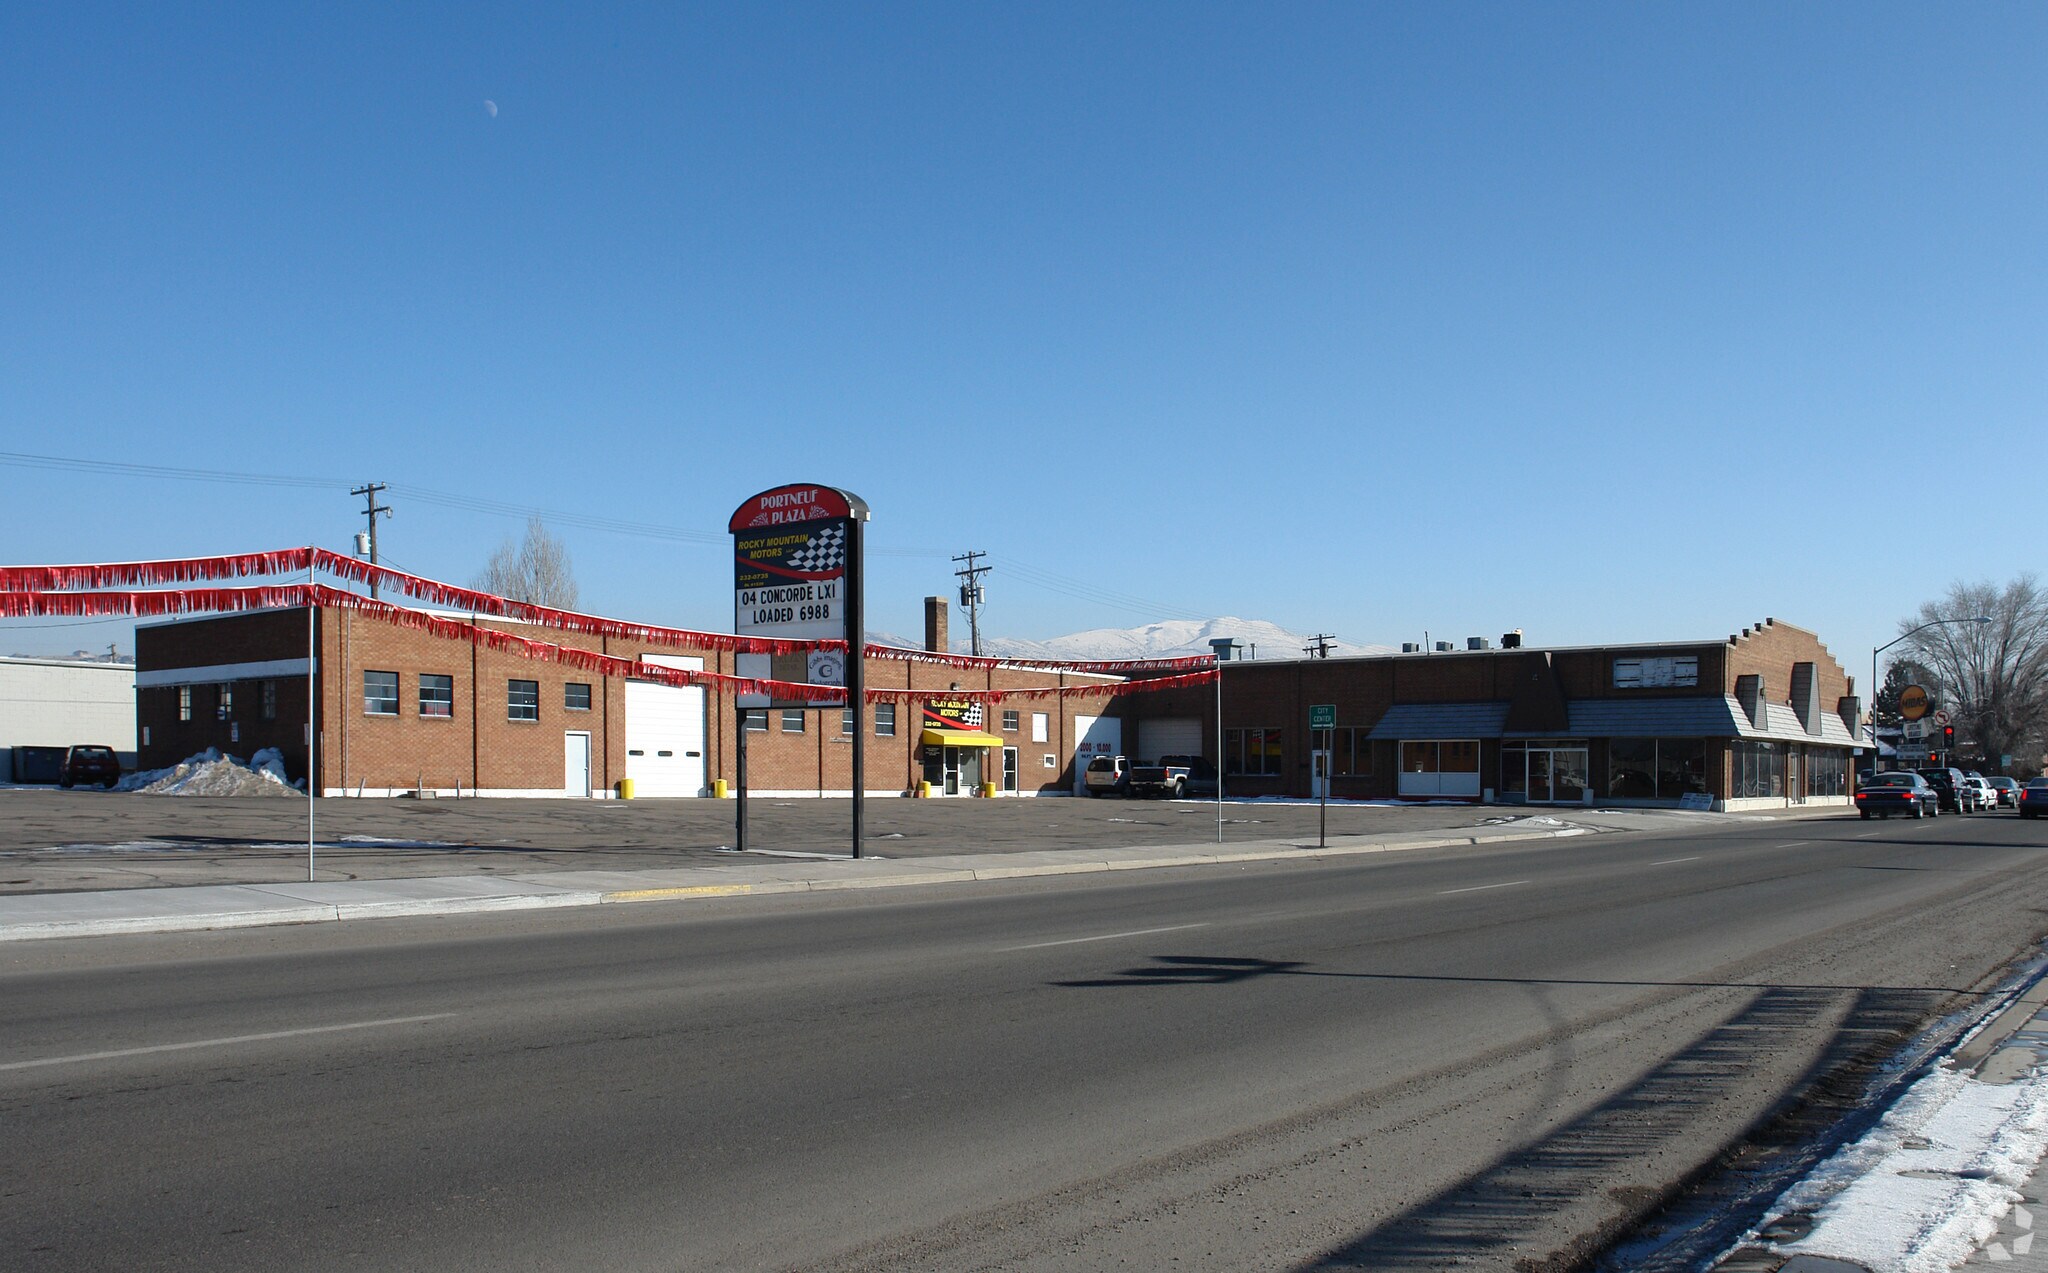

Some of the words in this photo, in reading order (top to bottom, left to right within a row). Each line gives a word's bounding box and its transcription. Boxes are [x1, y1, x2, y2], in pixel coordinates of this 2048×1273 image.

[760, 489, 818, 510] PORTNEUF
[771, 508, 806, 525] PLAZA
[738, 539, 765, 550] ROCKY
[766, 533, 809, 547] MOUNTAIN
[749, 547, 782, 560] MOTORS
[742, 591, 756, 606] 04
[760, 586, 813, 605] CONCORDE
[817, 583, 835, 600] LXI
[753, 607, 793, 624] LOADED
[799, 604, 829, 621] 6988
[940, 708, 959, 717] MOTORS
[1313, 715, 1332, 723] CENTER
